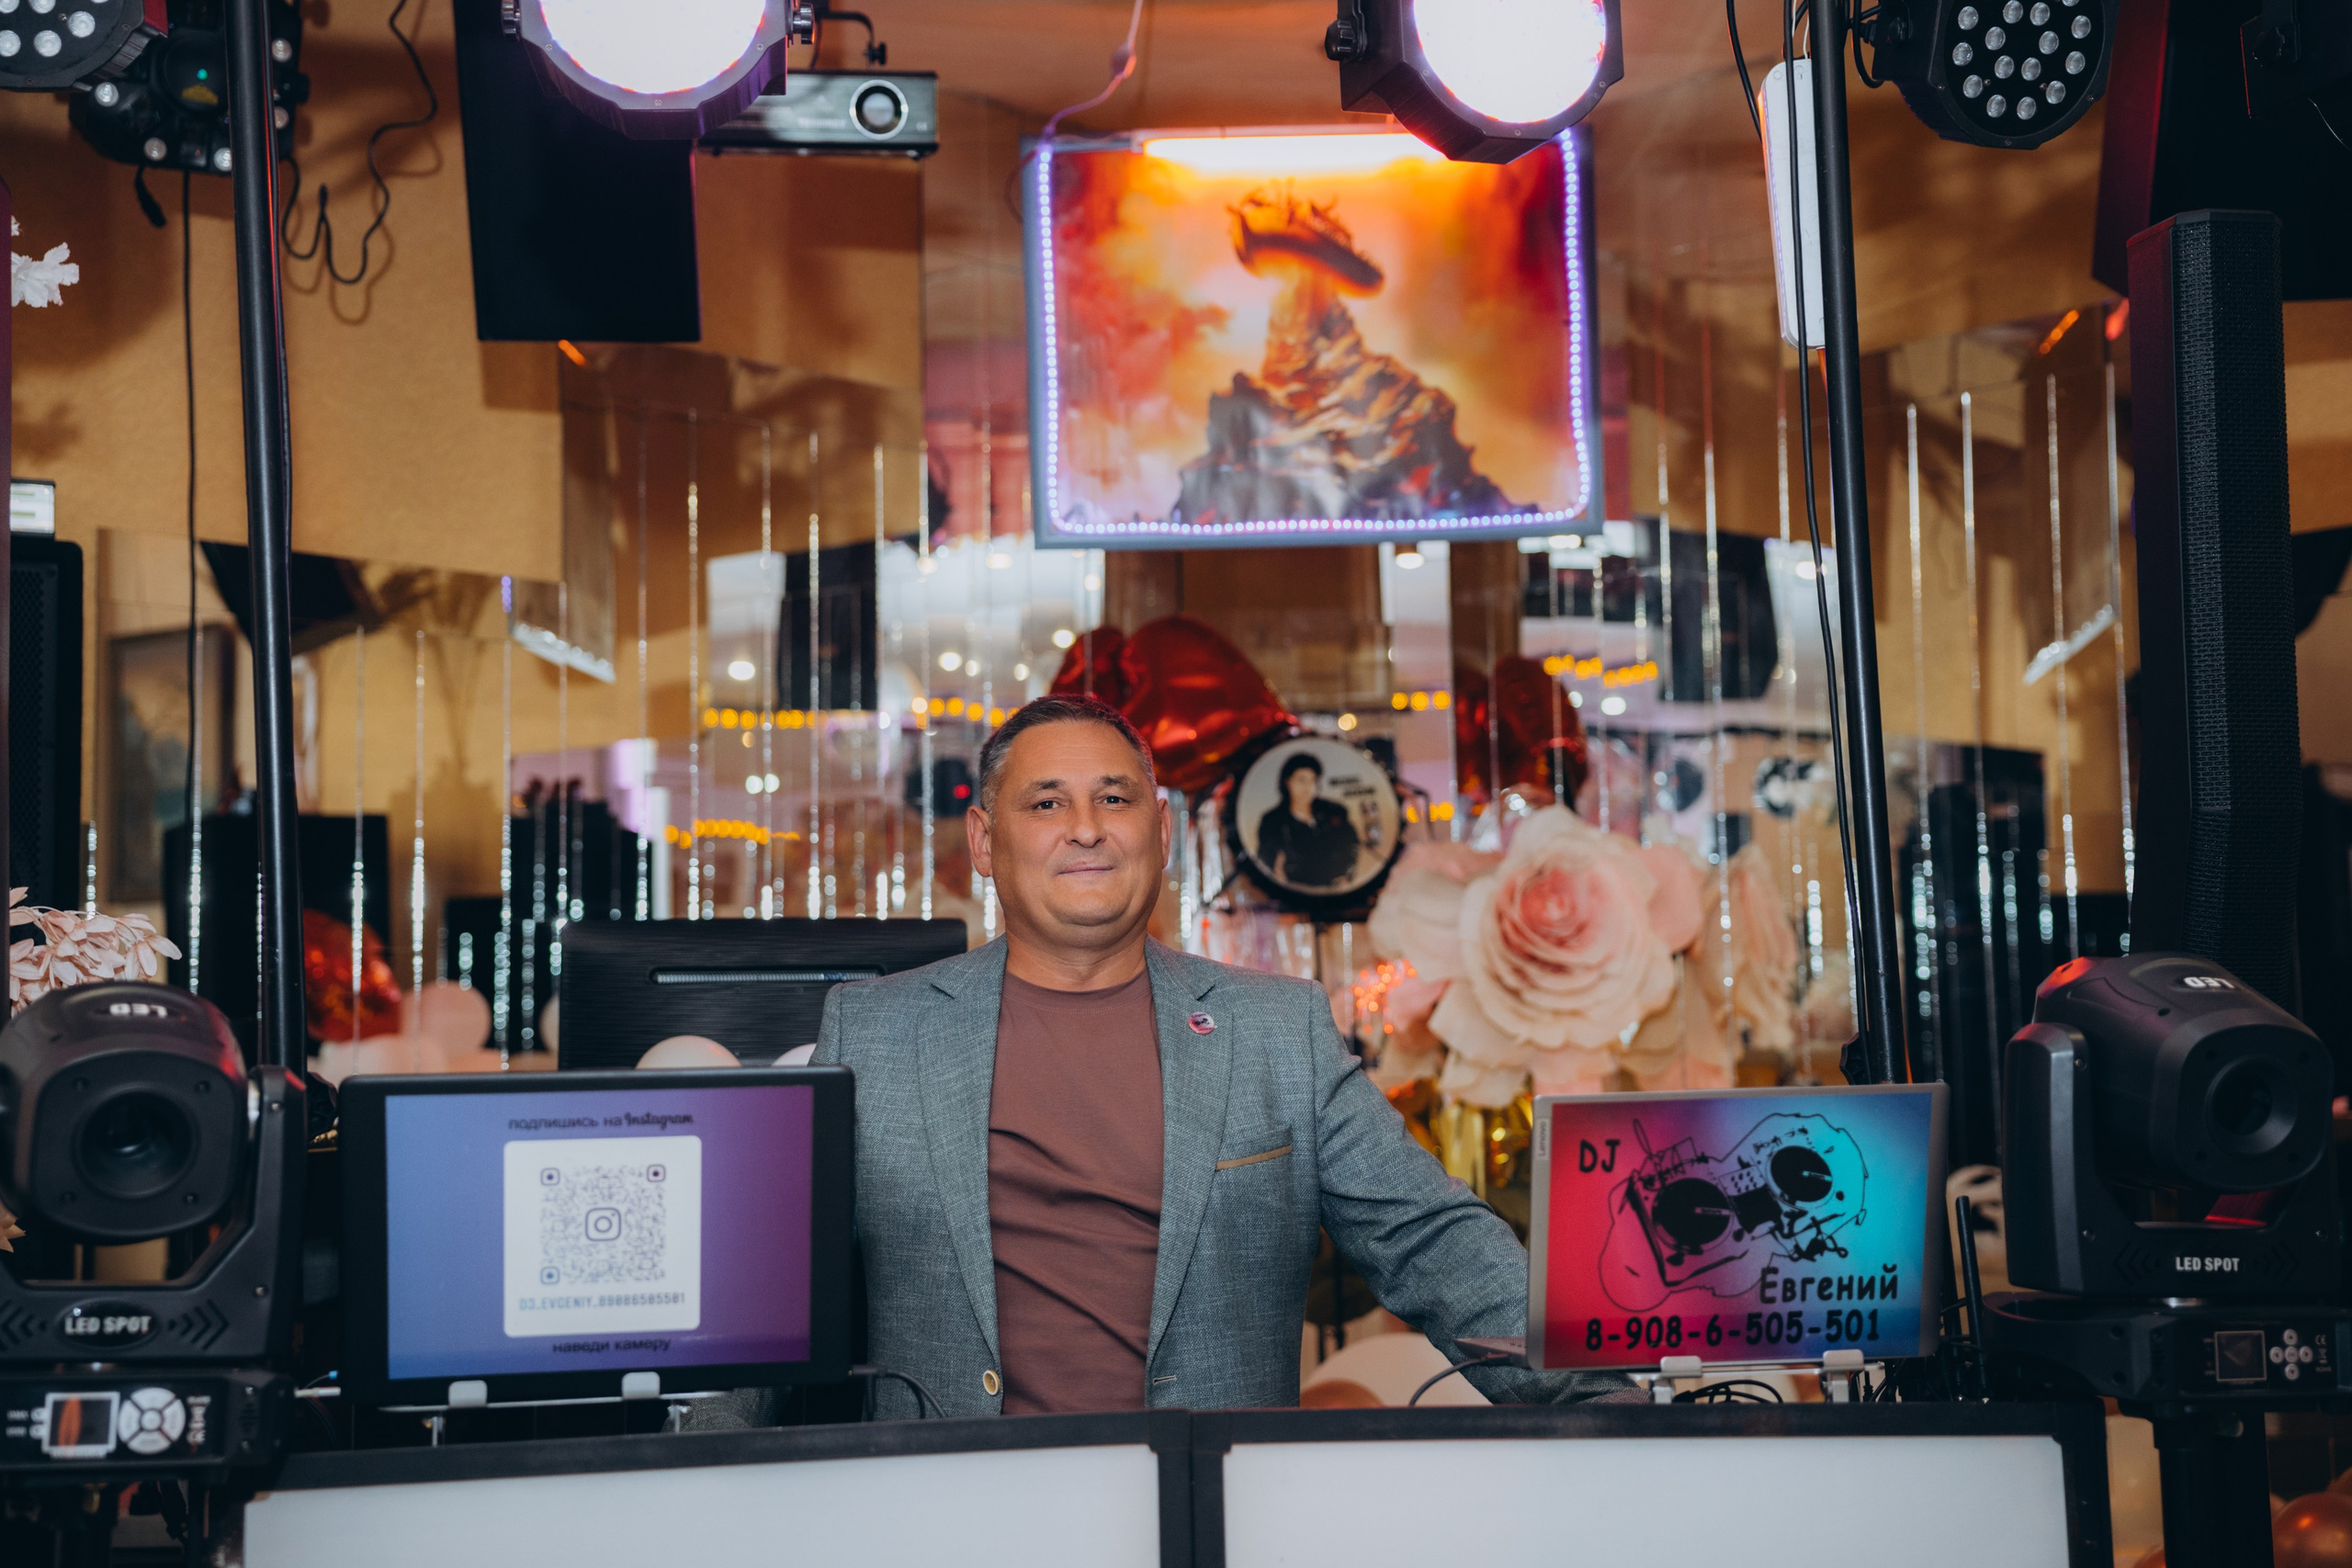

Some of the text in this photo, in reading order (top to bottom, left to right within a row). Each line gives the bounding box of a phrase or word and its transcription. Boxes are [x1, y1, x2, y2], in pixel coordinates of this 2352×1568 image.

[2183, 976, 2234, 989] LED
[109, 1003, 168, 1020] LED
[508, 1111, 694, 1132] подпишись на Instagram
[1578, 1139, 1622, 1173] DJ
[2176, 1256, 2241, 1272] LED SPOT
[1759, 1263, 1899, 1304] Евгений
[64, 1315, 152, 1335] LED SPOT
[1585, 1308, 1881, 1352] 8-908-6-505-501
[552, 1337, 673, 1353] наведи камеру
